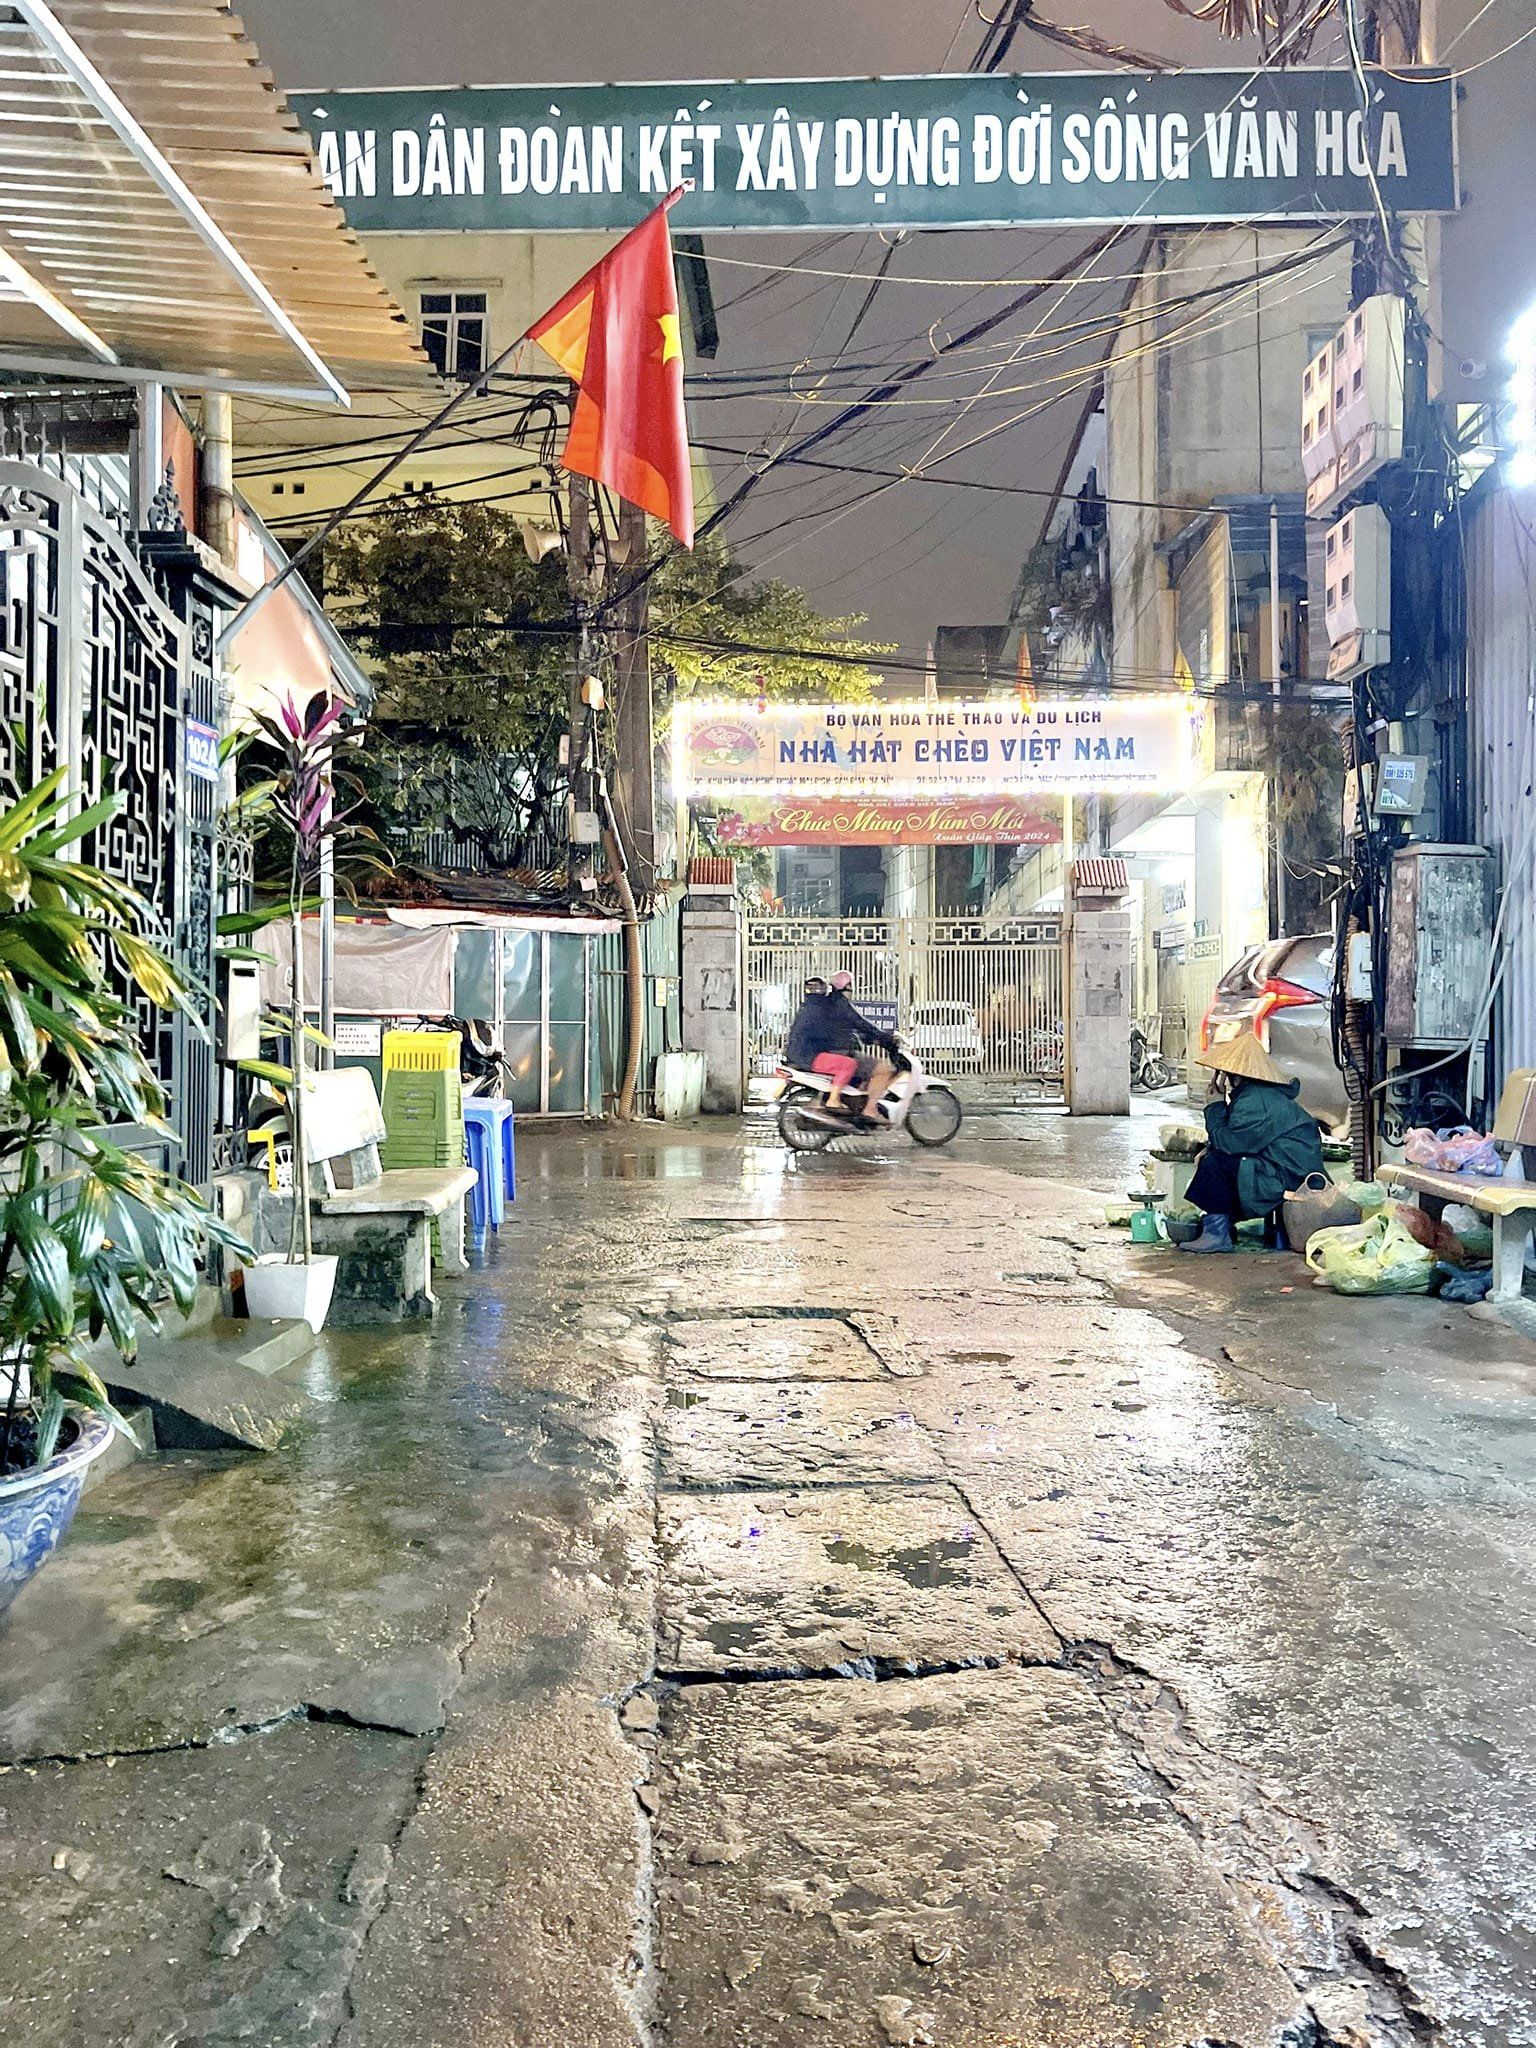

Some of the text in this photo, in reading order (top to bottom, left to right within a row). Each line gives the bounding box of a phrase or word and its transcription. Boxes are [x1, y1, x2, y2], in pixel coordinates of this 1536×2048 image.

[312, 108, 376, 197] ÀN
[392, 113, 485, 197] DÂN
[498, 103, 623, 195] ĐOÀN
[639, 99, 722, 193] KẾT
[734, 107, 826, 192] XÂY
[834, 112, 961, 204] DỰNG
[972, 89, 1052, 185] ĐỜI
[1061, 87, 1190, 183] SỐNG
[1204, 95, 1298, 178] VĂN
[1037, 711, 1057, 724] DU
[1065, 711, 1102, 726] LỊCH
[187, 734, 219, 769] 102A
[779, 731, 837, 763] NHÀ
[847, 731, 902, 763] HÁT
[914, 730, 989, 763] CHÈO
[999, 729, 1061, 768] VIỆT
[1073, 737, 1136, 762] NAM
[774, 807, 832, 834] Chúc
[905, 806, 969, 832] Năm
[1023, 831, 1051, 840] 2024
